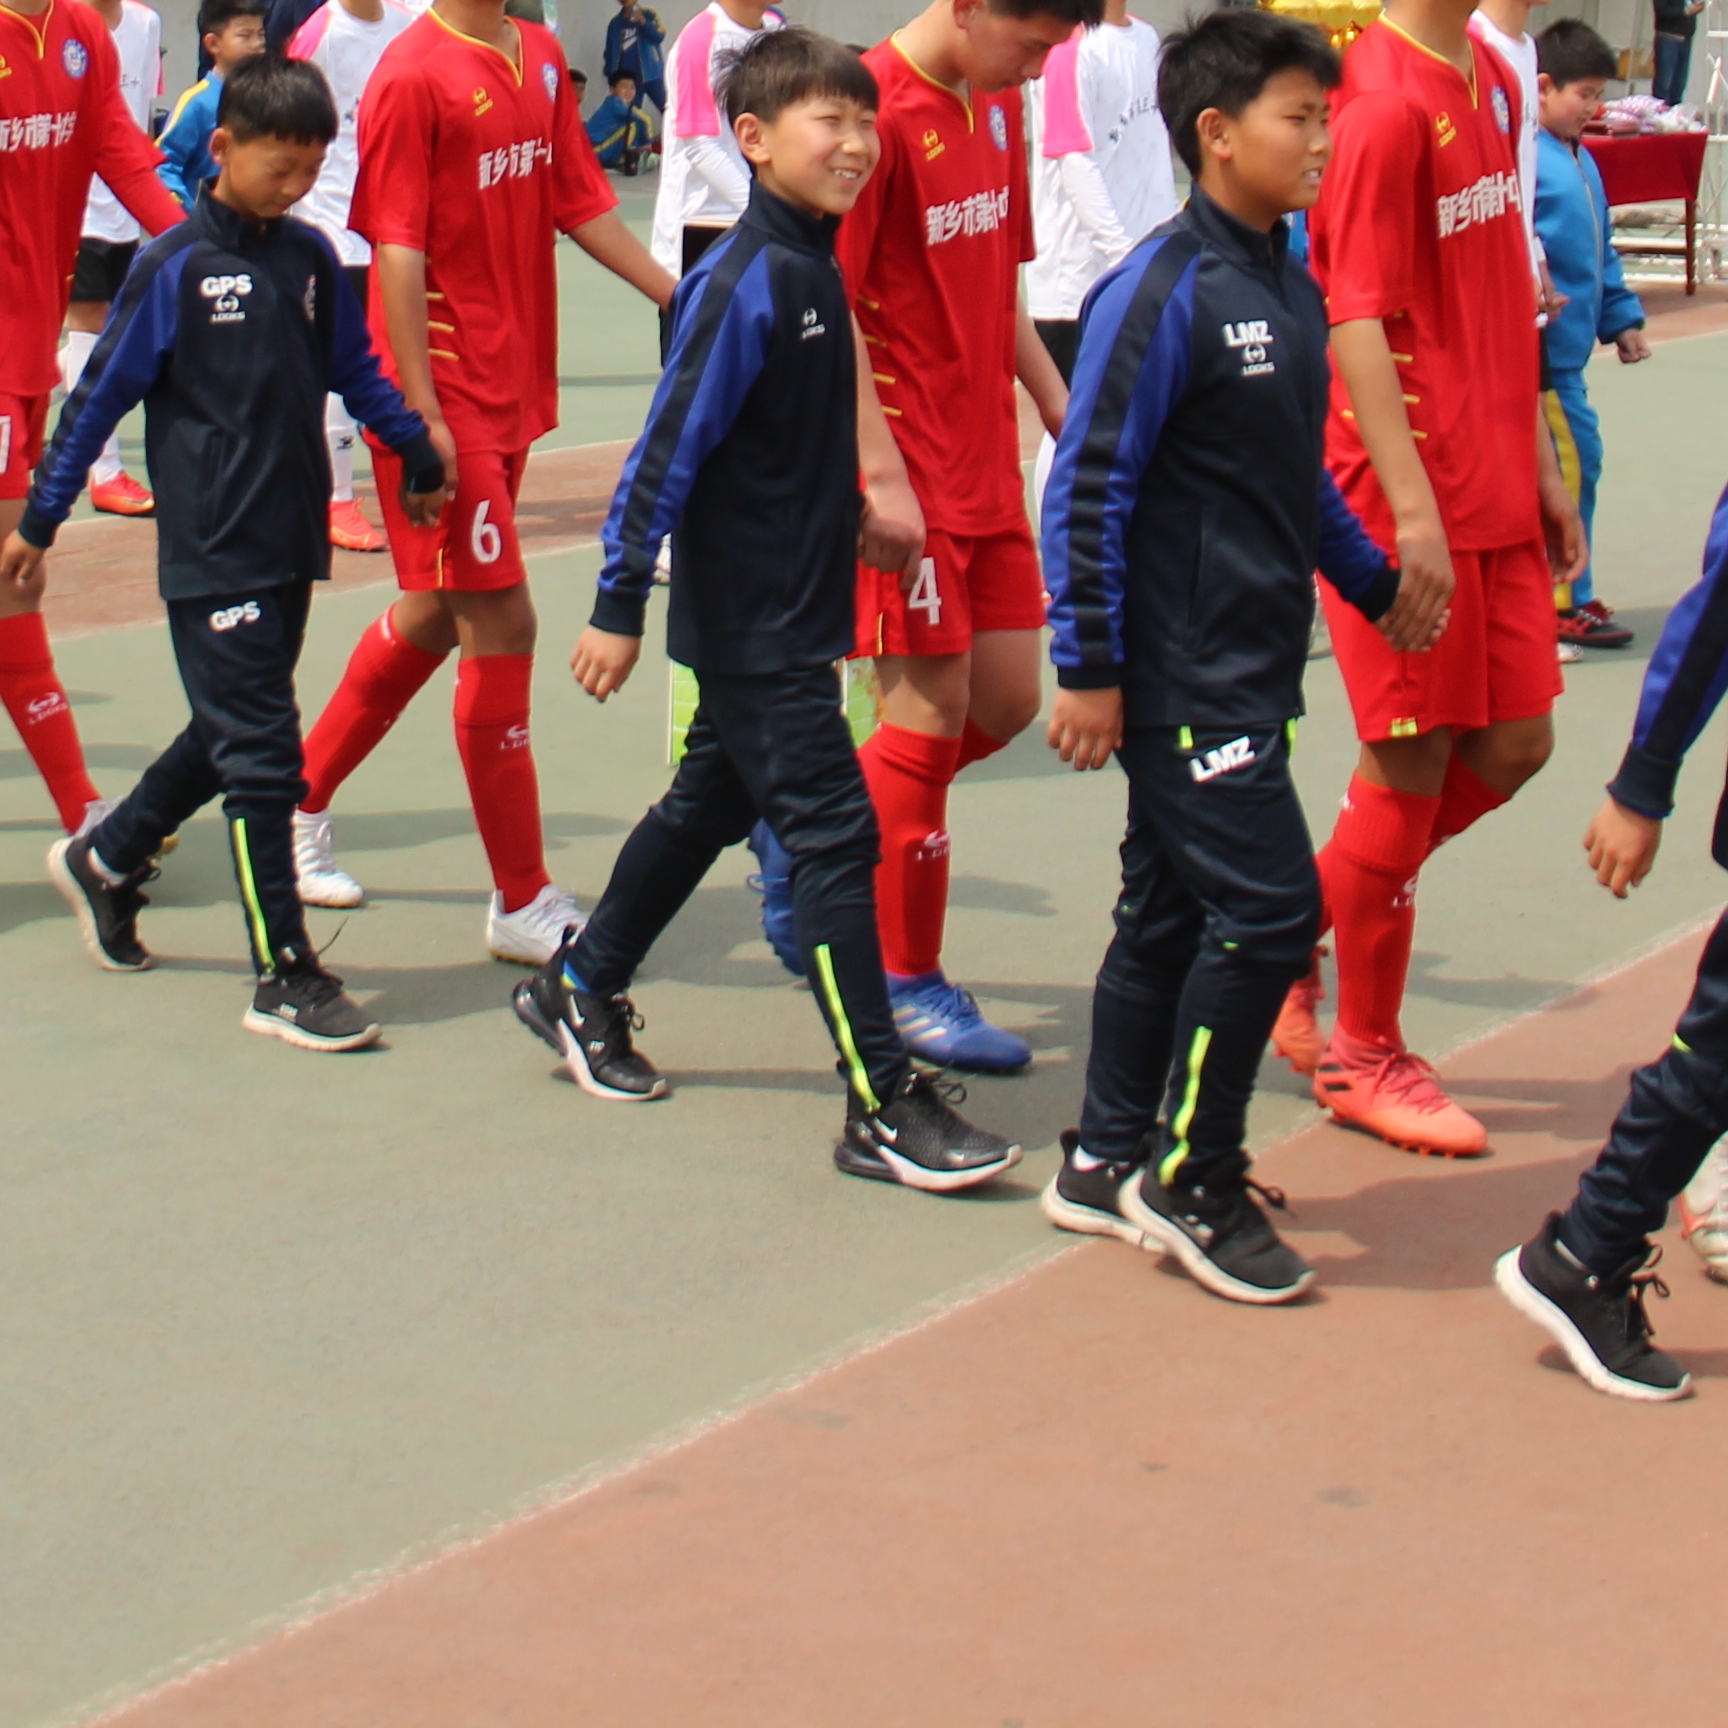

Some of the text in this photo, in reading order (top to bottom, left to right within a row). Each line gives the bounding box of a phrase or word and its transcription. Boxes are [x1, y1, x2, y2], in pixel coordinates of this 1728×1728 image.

[201, 273, 253, 298] GPS
[1222, 319, 1275, 347] LMZ
[471, 498, 502, 565] 6
[908, 556, 943, 626] 4
[209, 599, 262, 633] GPS
[1188, 734, 1257, 784] LMZ
